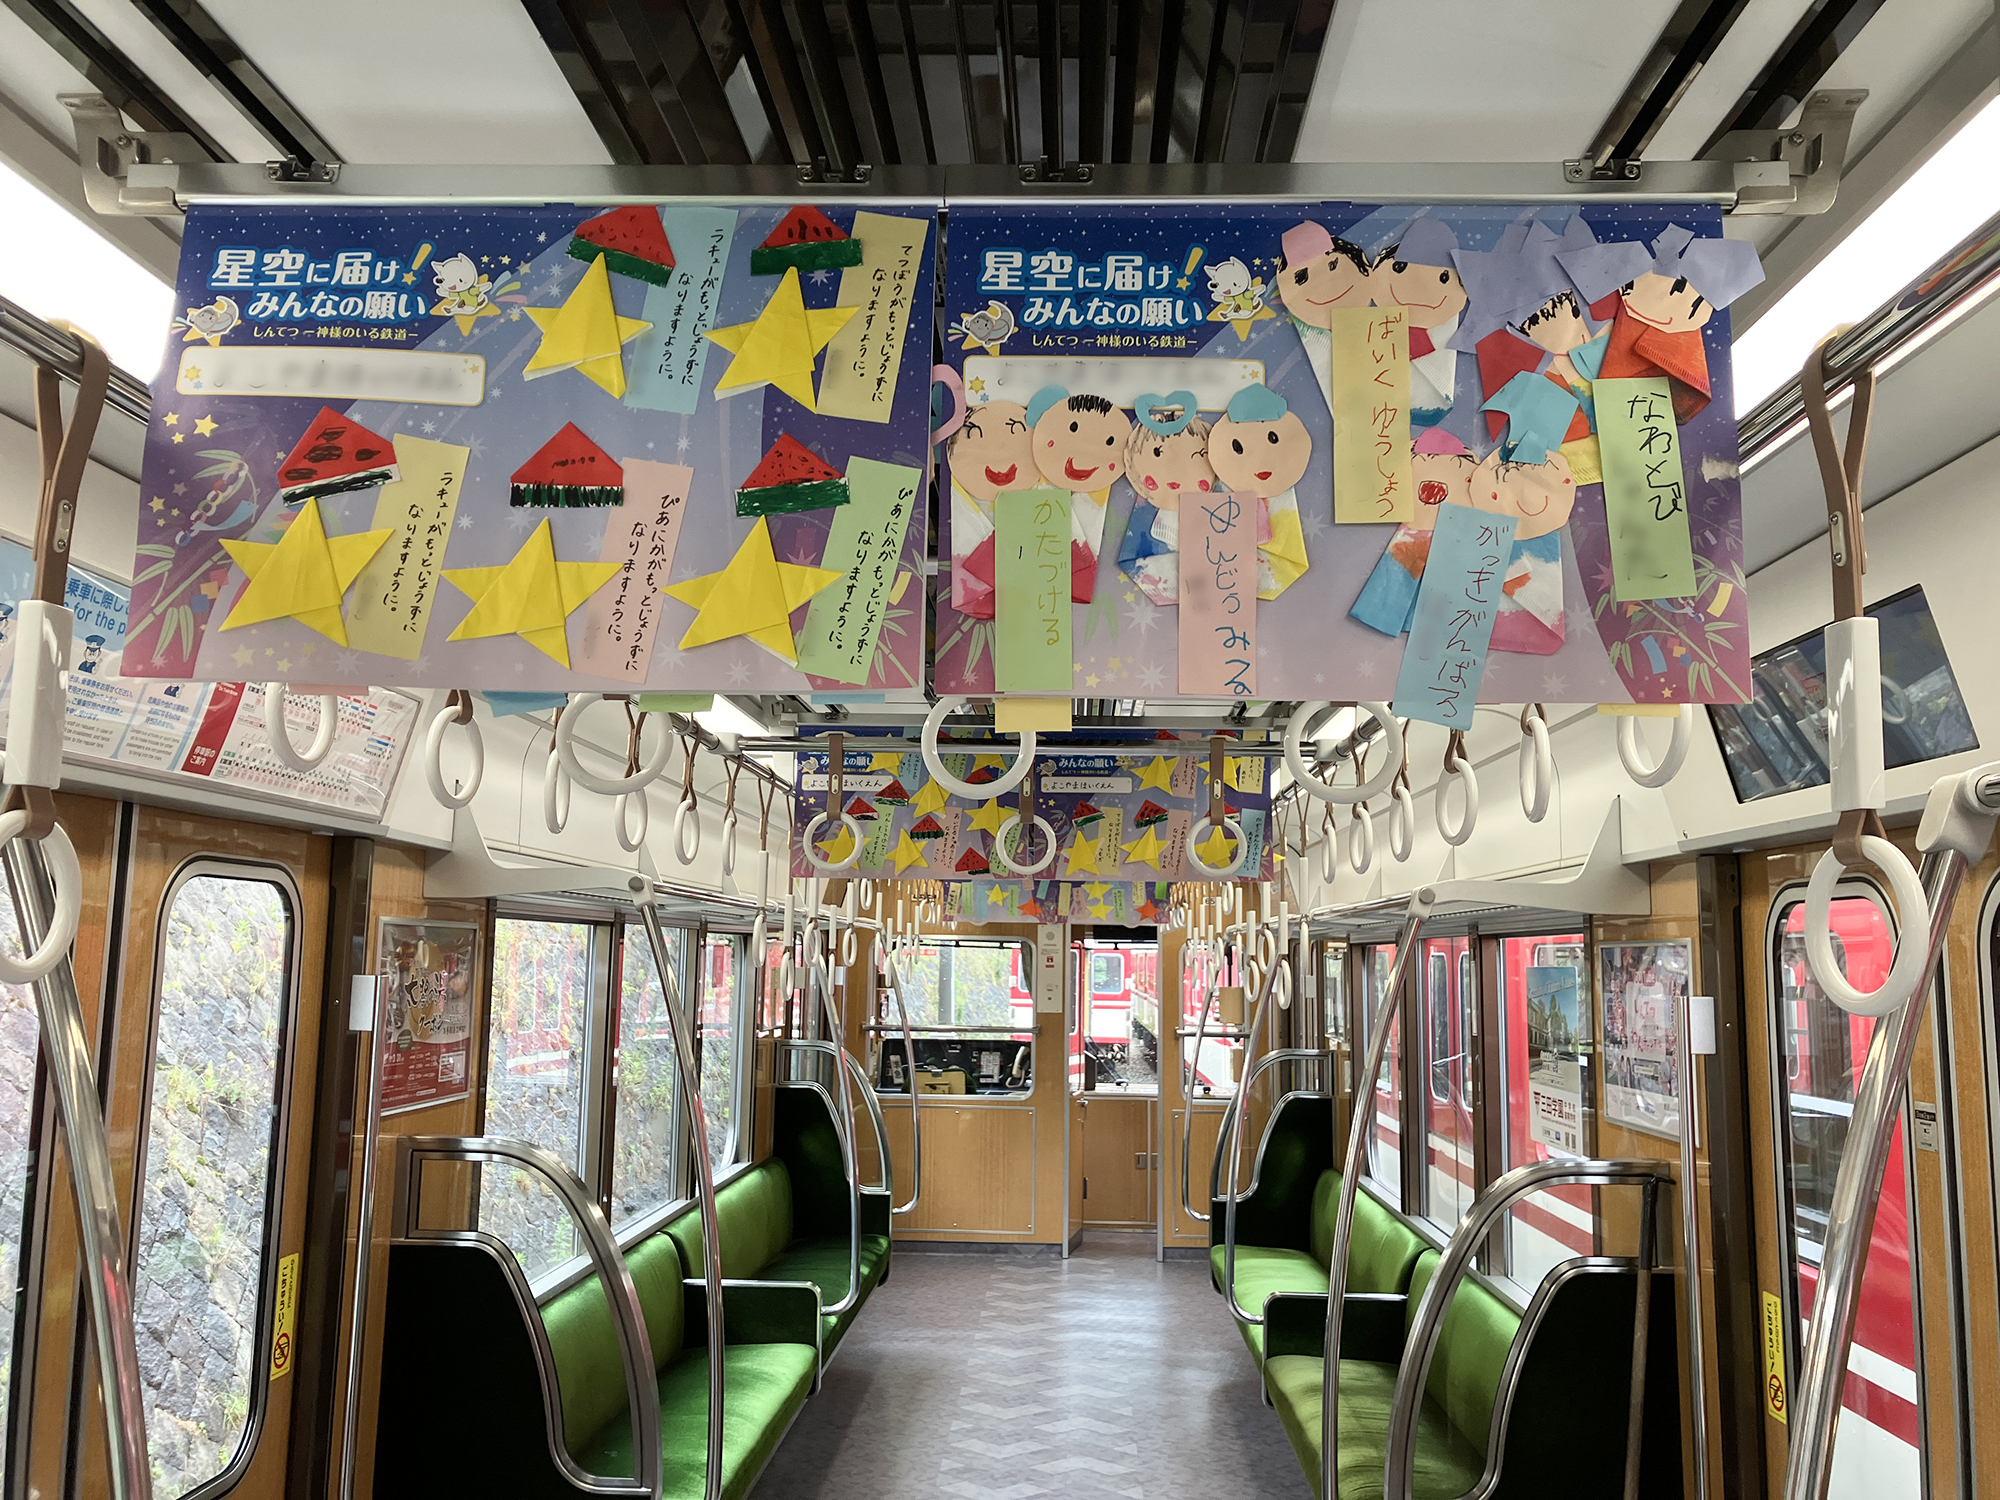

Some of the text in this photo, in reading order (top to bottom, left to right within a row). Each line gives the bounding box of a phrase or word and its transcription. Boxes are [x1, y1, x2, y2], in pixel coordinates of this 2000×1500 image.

[249, 291, 427, 319] みんなの願い
[659, 272, 694, 380] なりますように。
[681, 228, 724, 386] ラキューがもっとじょうずに
[853, 268, 887, 378] なりますように。
[872, 245, 913, 402] てつぼうがもっとじょうずに
[1024, 297, 1203, 326] みんなの願い
[1627, 391, 1683, 521] なわとび
[65, 576, 129, 615] 乗車に際し
[383, 504, 424, 612] なりますように。
[403, 472, 453, 633] ラキューがもっとじょうずに
[607, 522, 648, 642] なりますように。
[828, 530, 873, 650] なりますように。
[1033, 499, 1066, 646] かたづける
[74, 602, 92, 622] for
[95, 610, 115, 631] the
[1051, 781, 1114, 790] よこやまほいくえん
[1059, 758, 1114, 768] みんなの願い
